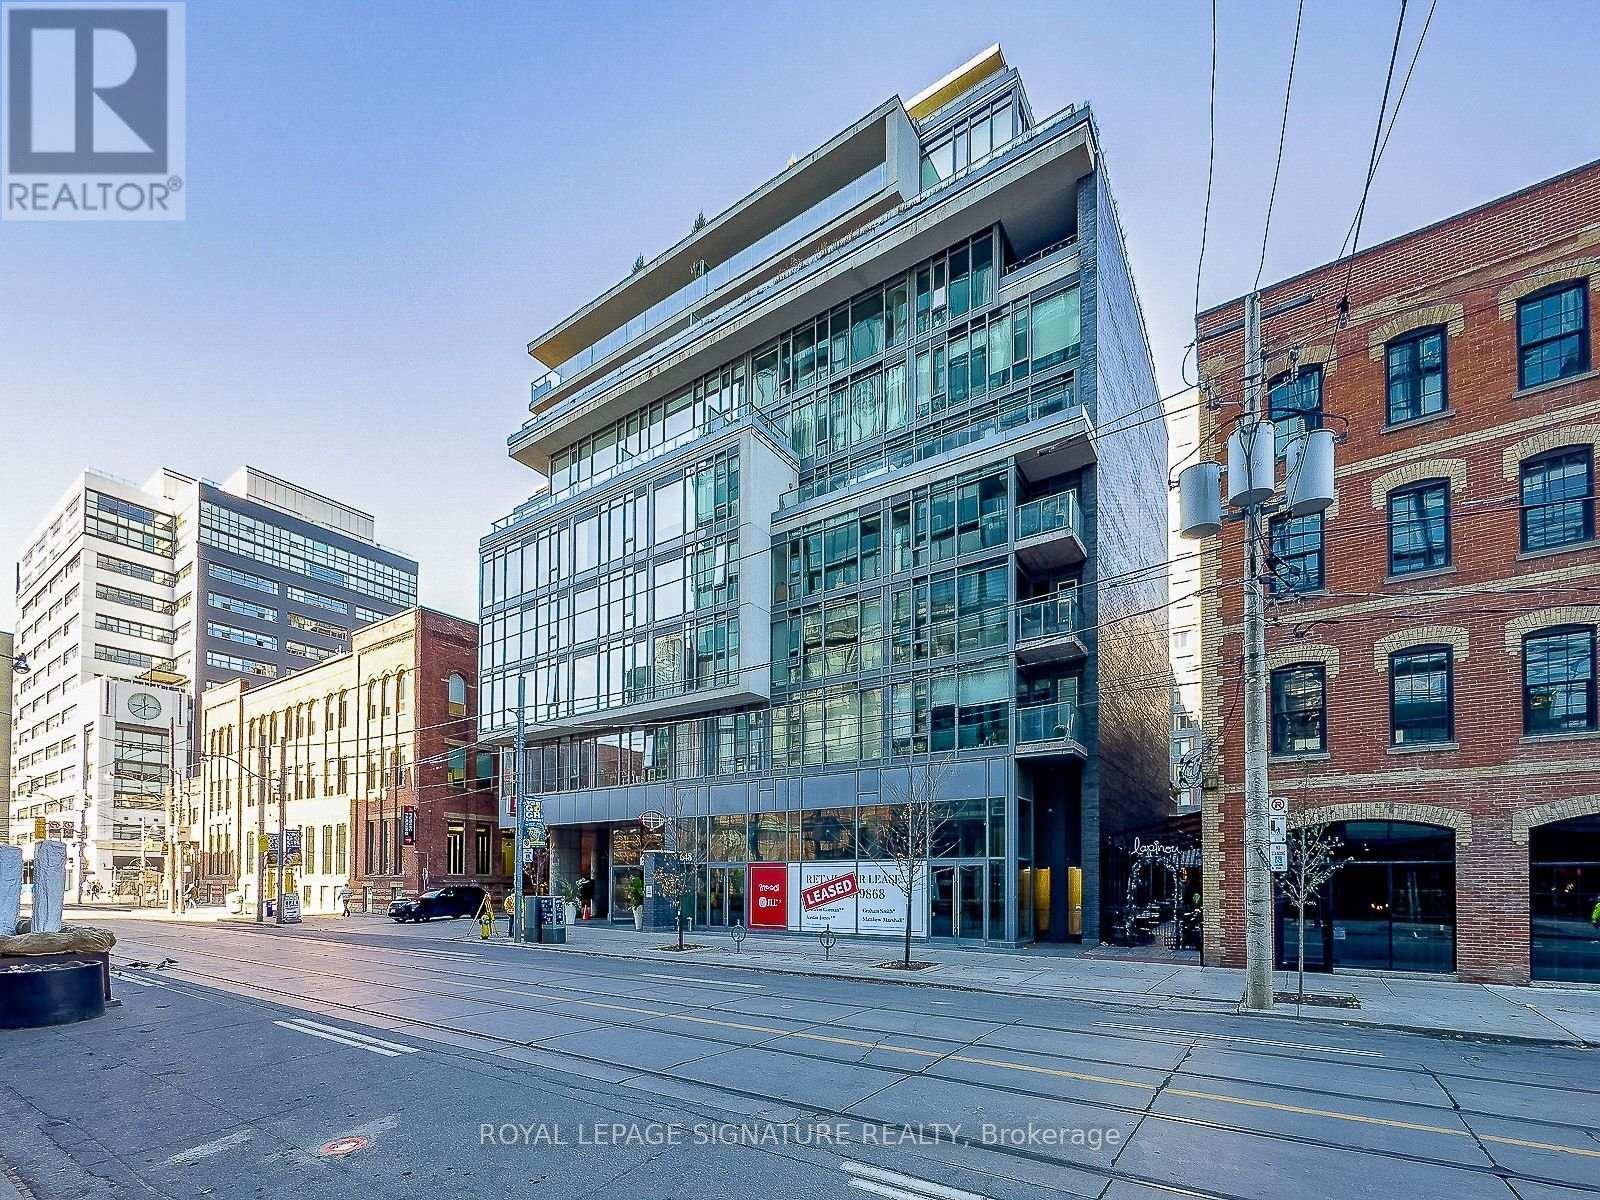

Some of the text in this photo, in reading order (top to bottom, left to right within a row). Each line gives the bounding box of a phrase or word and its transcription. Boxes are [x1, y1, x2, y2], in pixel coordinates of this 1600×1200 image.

[680, 852, 693, 861] 648
[1131, 836, 1182, 857] lapinou
[806, 879, 853, 905] LEASED
